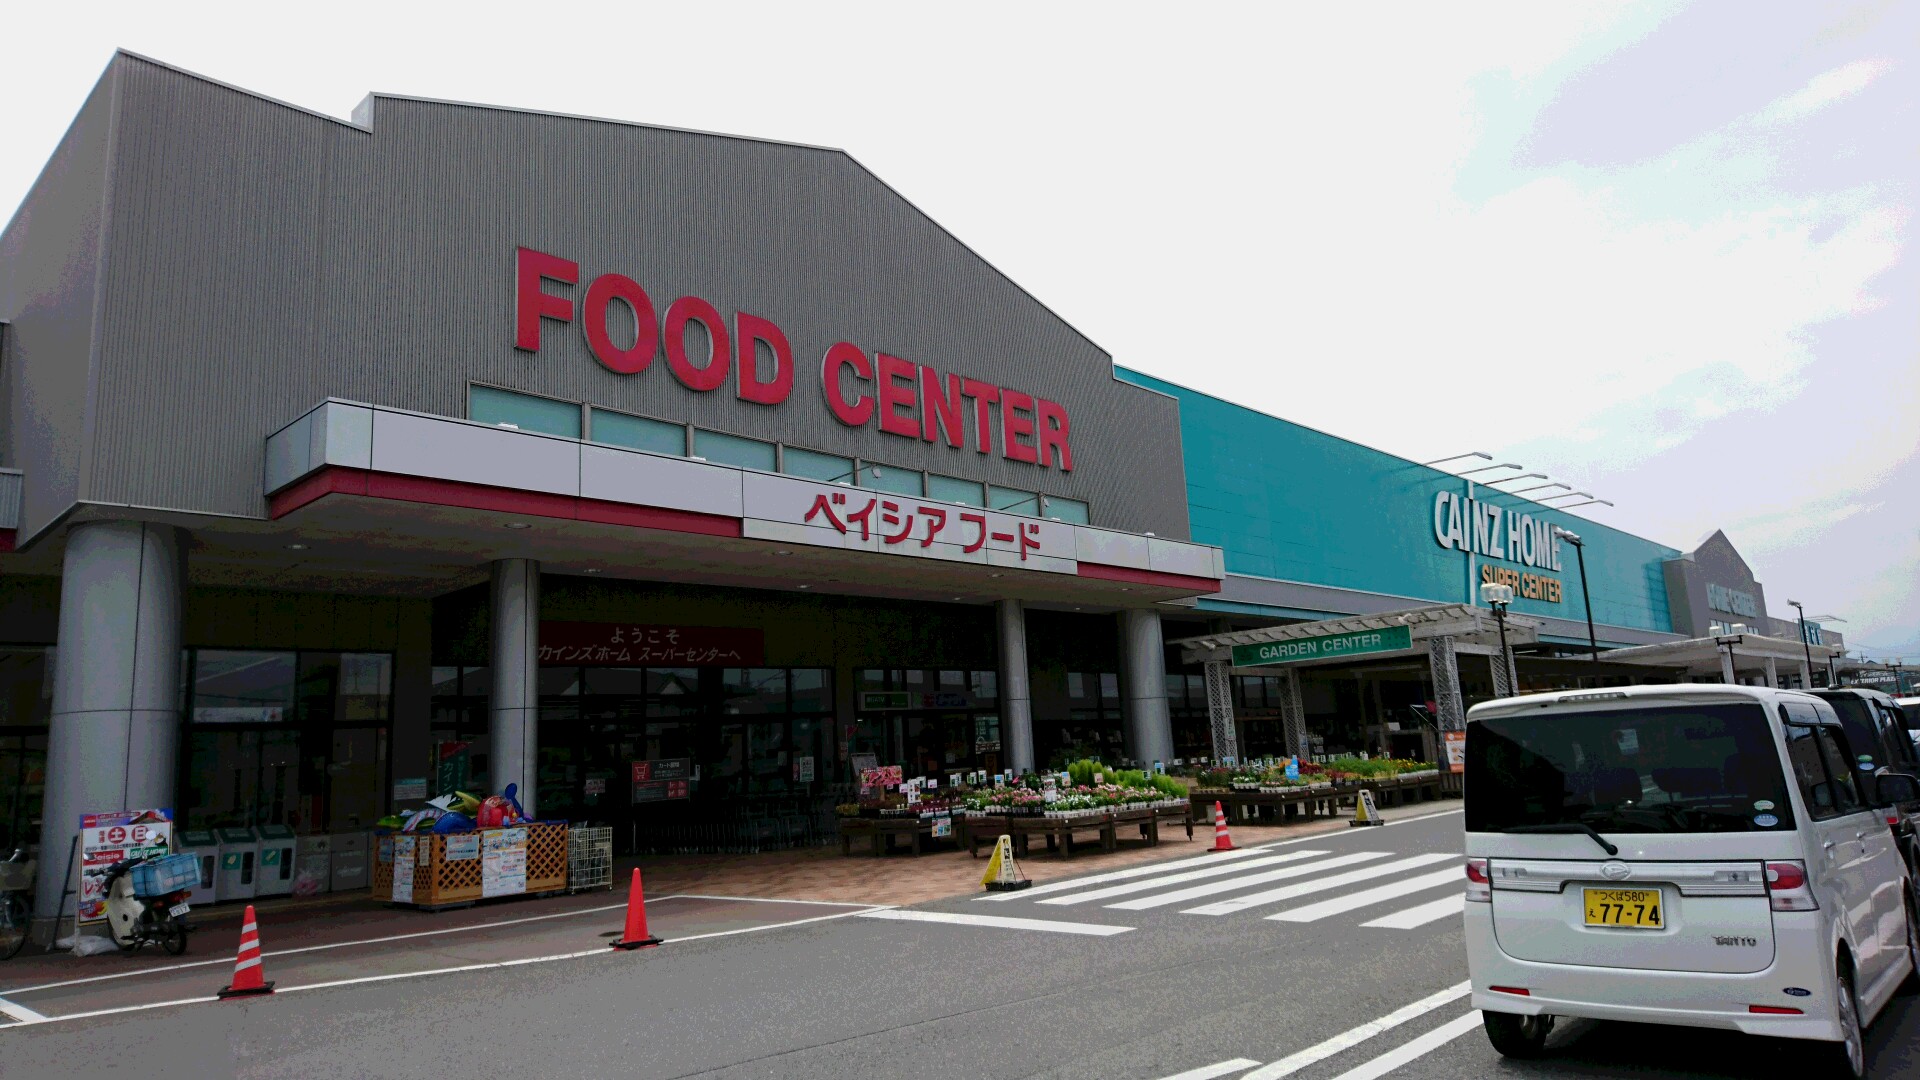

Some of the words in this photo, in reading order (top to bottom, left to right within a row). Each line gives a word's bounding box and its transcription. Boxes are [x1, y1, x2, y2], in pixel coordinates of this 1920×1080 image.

[514, 247, 794, 405] FOOD
[821, 341, 1073, 472] CENTER
[805, 494, 947, 547] ベイシア
[961, 514, 1041, 561] フード
[1434, 490, 1505, 559] CAINZ
[1507, 510, 1562, 572] HOME
[1482, 564, 1521, 597] SUPER
[1522, 572, 1563, 604] CENTER
[610, 627, 681, 644] ようこそ
[1259, 641, 1317, 660] GARDEN
[1322, 634, 1382, 651] CENTER
[538, 643, 631, 662] カインズホーム
[638, 646, 742, 663] スーパーセンターへ
[1599, 891, 1645, 902] つくば580
[1588, 908, 1597, 918] え
[1599, 903, 1660, 925] 77-74
[1712, 936, 1757, 947] TANTO
